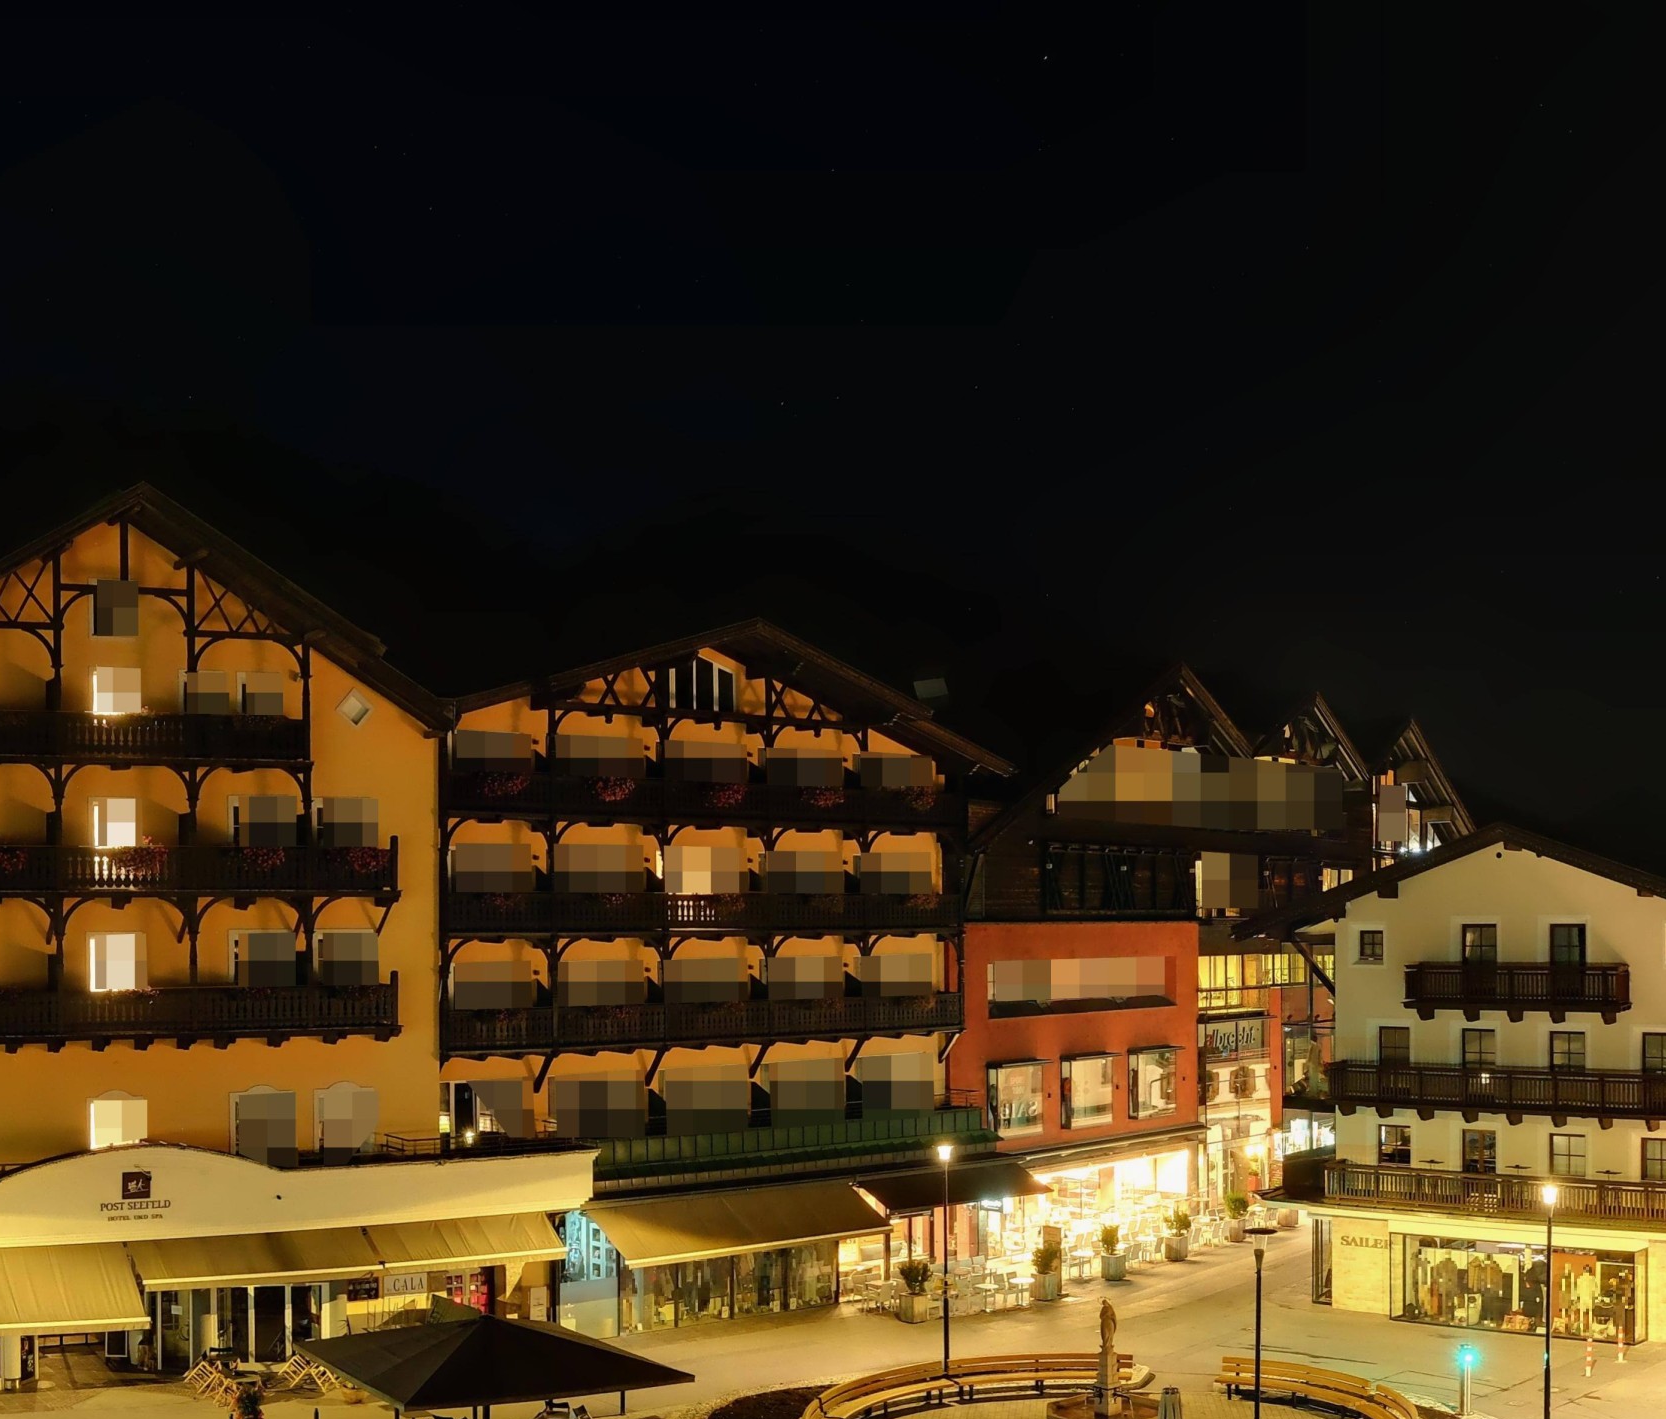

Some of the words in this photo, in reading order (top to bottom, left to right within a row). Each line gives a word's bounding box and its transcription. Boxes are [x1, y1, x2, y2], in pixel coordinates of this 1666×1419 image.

[100, 1202, 125, 1212] POST
[127, 1200, 171, 1211] SEEFELD
[393, 1277, 424, 1292] CALA
